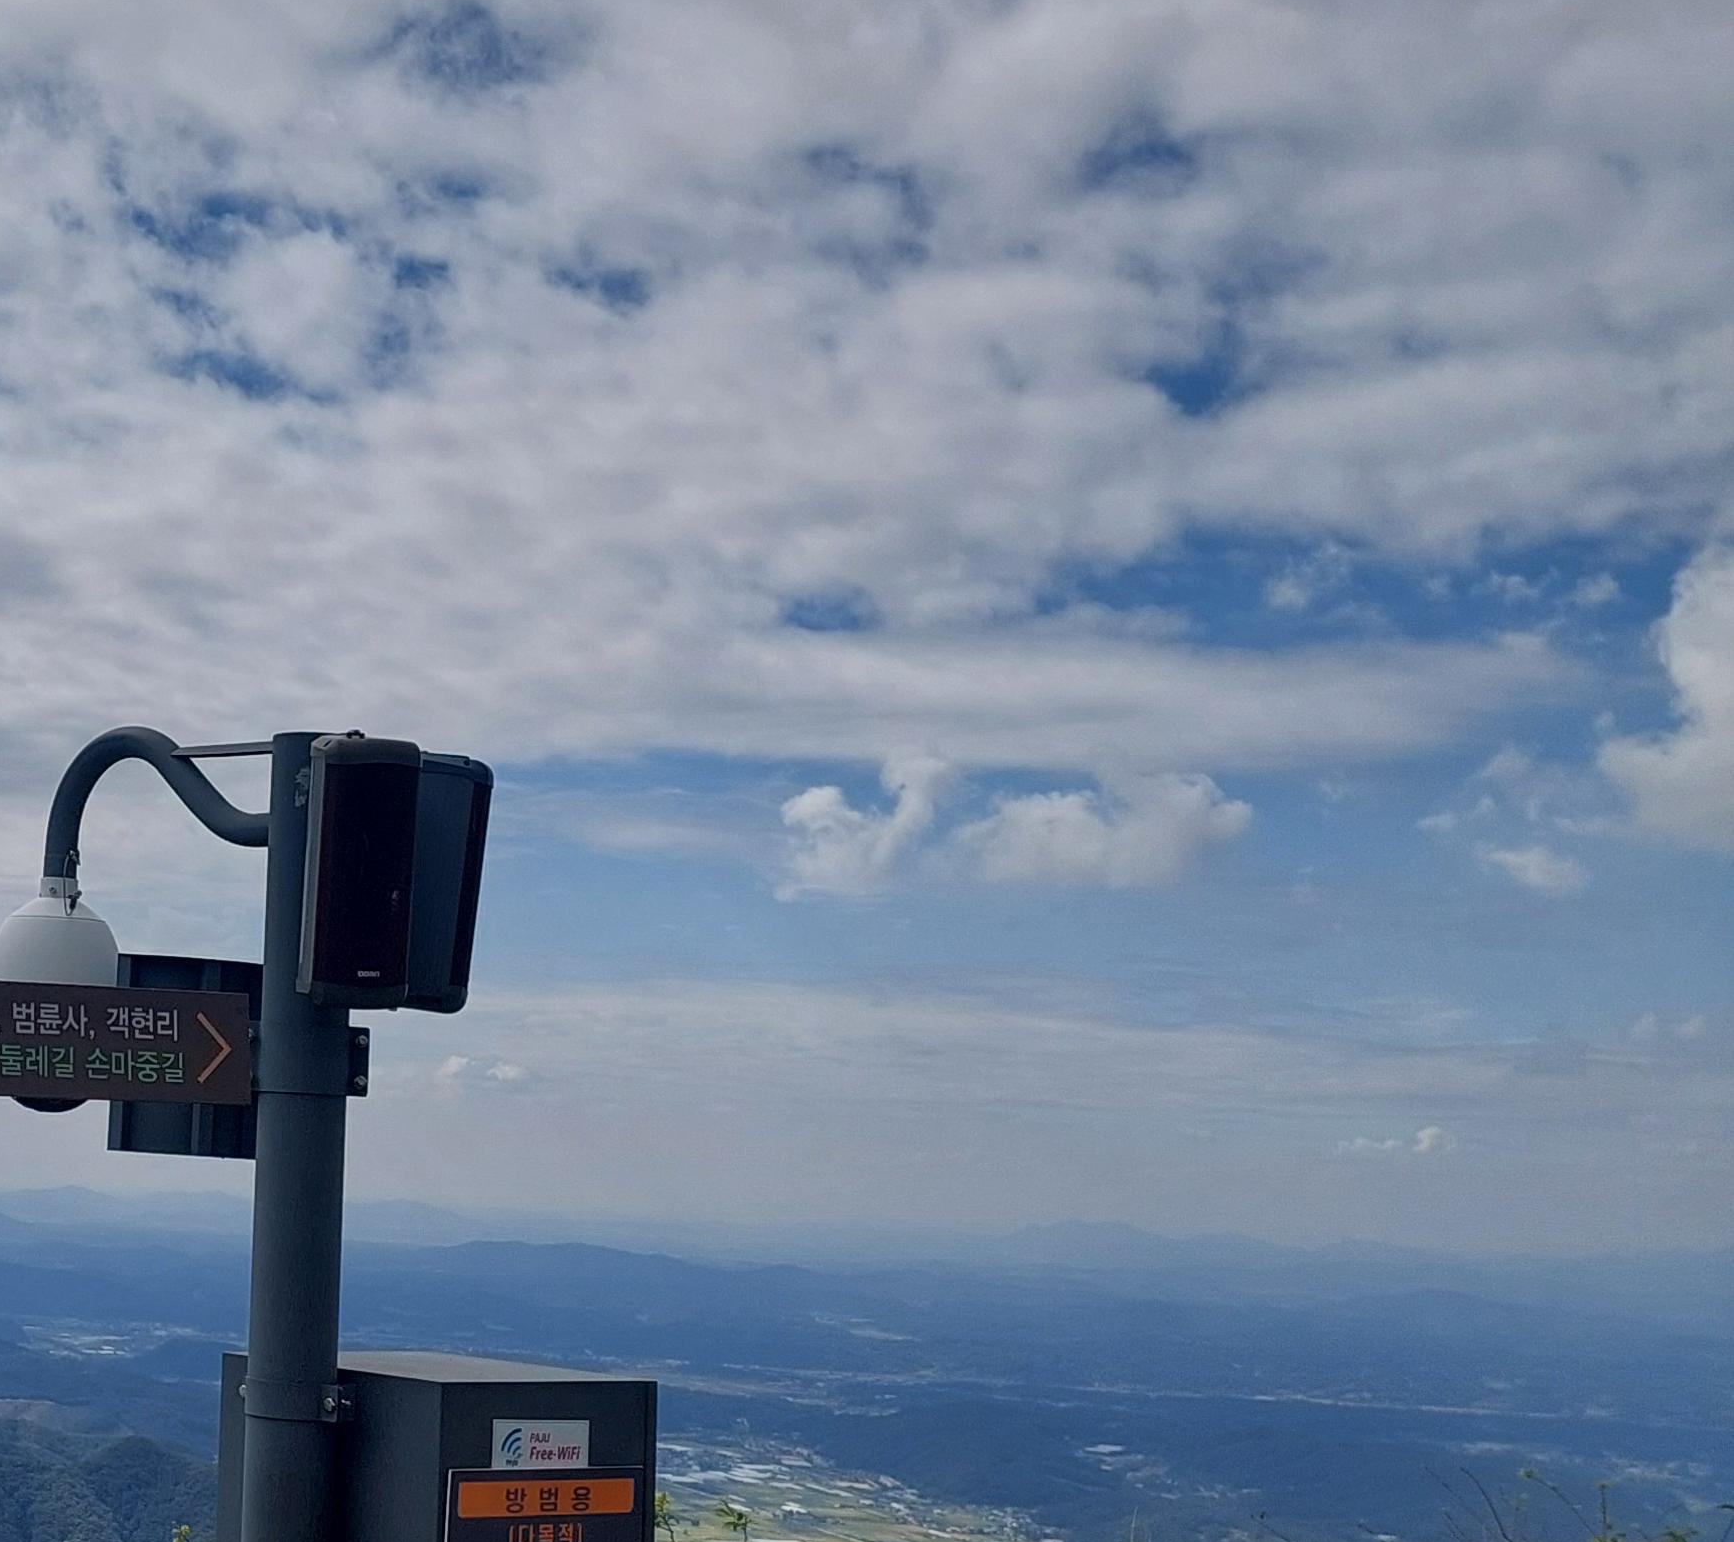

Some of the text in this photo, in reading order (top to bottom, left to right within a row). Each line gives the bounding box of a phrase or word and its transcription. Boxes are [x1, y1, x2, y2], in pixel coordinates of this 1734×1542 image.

[12, 1001, 96, 1040] 범륜사,
[105, 1006, 180, 1043] 객현리
[86, 1047, 185, 1084] 손마중길
[530, 1432, 551, 1444] PAJU
[529, 1445, 582, 1461] Free-WiFi
